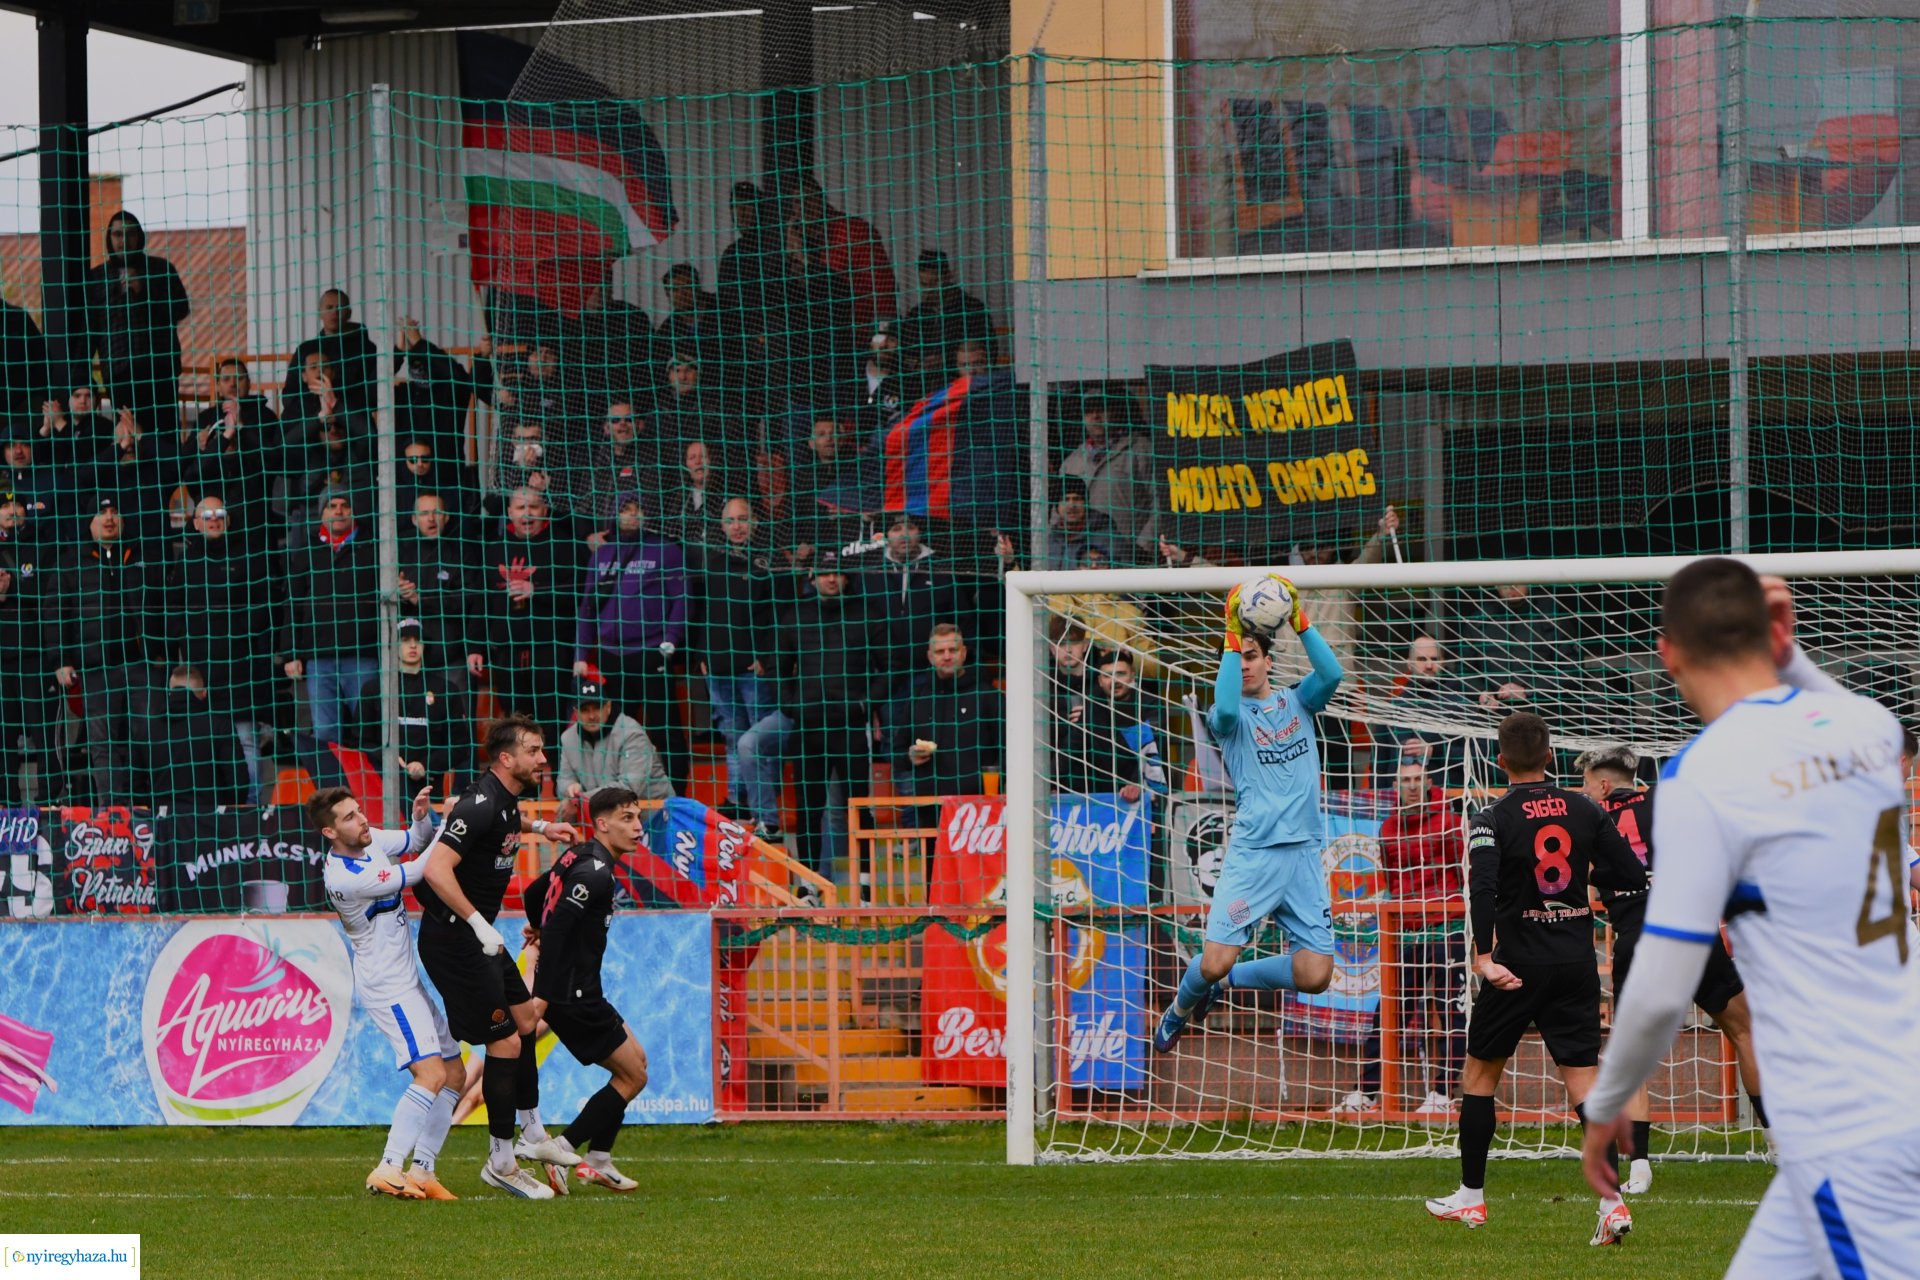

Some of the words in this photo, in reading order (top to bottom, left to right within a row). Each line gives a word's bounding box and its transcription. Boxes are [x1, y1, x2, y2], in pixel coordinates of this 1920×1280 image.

[1243, 375, 1353, 434] NEMICI
[1167, 464, 1262, 513] MOLTO
[1267, 448, 1376, 505] ONORE
[948, 803, 1007, 855] Old
[1521, 794, 1568, 819] SIGÉR
[185, 838, 322, 882] MUNKÁCSY
[1534, 824, 1572, 895] 8
[1856, 804, 1909, 966] 4
[156, 973, 331, 1098] Aquarius
[217, 1036, 325, 1052] NYÍREGYHÁZA
